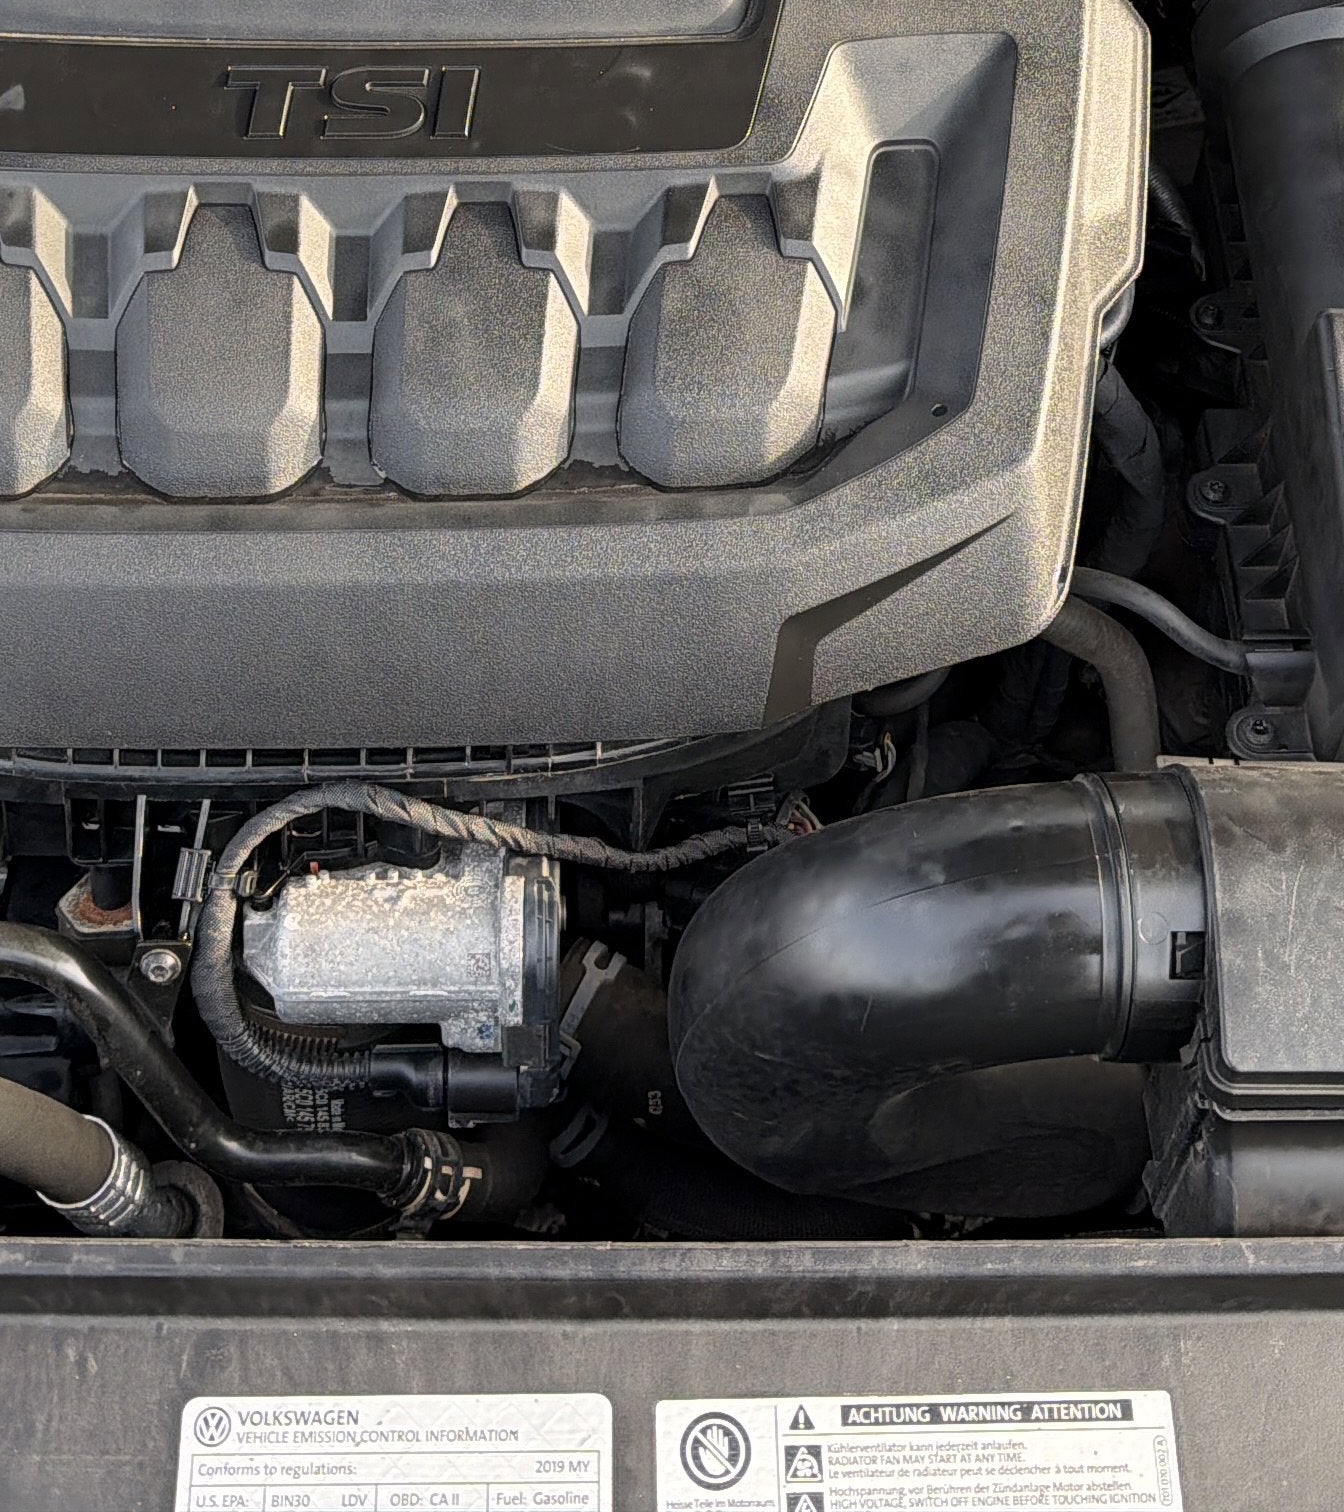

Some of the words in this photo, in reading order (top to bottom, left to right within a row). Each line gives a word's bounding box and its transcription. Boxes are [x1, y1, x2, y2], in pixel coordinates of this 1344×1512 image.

[224, 63, 482, 141] TSI
[238, 1410, 359, 1425] VOLKSWAGEN
[848, 1406, 931, 1424] ACHTUNG
[940, 1405, 1021, 1421] WARNING
[1031, 1403, 1121, 1420] ATTENTION
[236, 1431, 288, 1444] VEHICLE
[293, 1431, 355, 1443] EMISSION
[360, 1430, 420, 1443] CONTROL
[426, 1429, 519, 1441] INFORMATION
[827, 1443, 907, 1453] Kühlerventilator
[910, 1441, 933, 1451] kann
[936, 1441, 977, 1453] jederzeit
[981, 1440, 1027, 1450] anlaufen.
[828, 1456, 877, 1465] RADIATOR
[880, 1456, 900, 1465] FAN
[903, 1455, 925, 1464] MAY
[928, 1454, 956, 1463] START
[960, 1454, 971, 1463] AT
[975, 1453, 995, 1463] ANY
[998, 1453, 1026, 1462] TIME.
[198, 1464, 260, 1476] Conforms
[264, 1465, 277, 1476] to
[281, 1463, 357, 1478] regulations:
[535, 1461, 564, 1473] 2019
[569, 1461, 590, 1472] MY
[829, 1469, 838, 1479] Le
[841, 1468, 895, 1478] ventilateur
[898, 1467, 910, 1476] de
[913, 1466, 957, 1476] radiateur
[961, 1466, 982, 1478] peut
[986, 1467, 996, 1475] se
[1055, 1464, 1061, 1473] à
[1063, 1464, 1083, 1473] tout
[1087, 1463, 1133, 1473] moment.
[910, 1486, 923, 1494] vor
[927, 1484, 970, 1494] Berühren
[974, 1484, 989, 1494] der
[992, 1483, 1050, 1496] Zündanlage
[1053, 1483, 1083, 1492] Motor
[196, 1495, 216, 1507] U.S.
[223, 1495, 249, 1507] EPA:
[271, 1495, 310, 1507] BIN30
[342, 1494, 368, 1507] LDV
[390, 1493, 423, 1506] OBD:
[430, 1493, 449, 1506] CA
[496, 1492, 526, 1506] Fuel:
[533, 1491, 589, 1505] Gasoline
[831, 1499, 857, 1509] HIGH
[860, 1498, 907, 1509] VOLTAGE,
[909, 1497, 947, 1507] SWITCH
[950, 1497, 968, 1506] OFF
[971, 1496, 1010, 1506] ENGINE
[1013, 1495, 1049, 1505] BEFORE
[1052, 1495, 1106, 1505] TOUCHING
[1109, 1494, 1155, 1503] IGNITION
